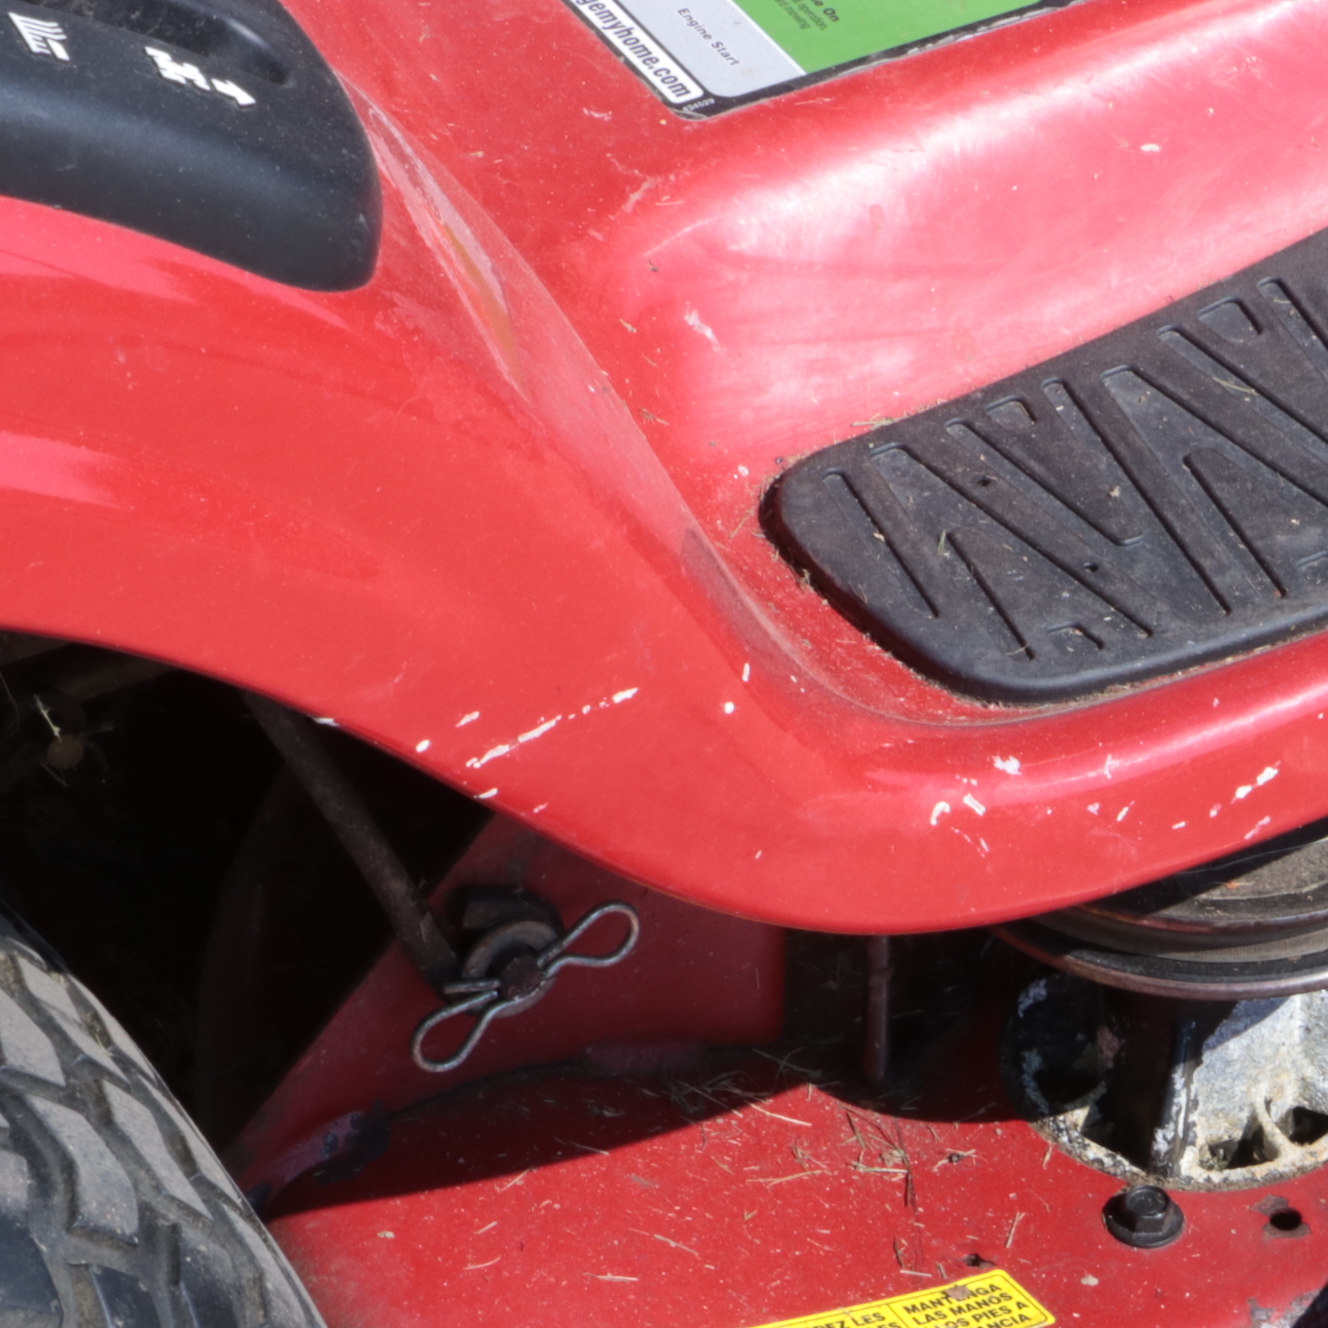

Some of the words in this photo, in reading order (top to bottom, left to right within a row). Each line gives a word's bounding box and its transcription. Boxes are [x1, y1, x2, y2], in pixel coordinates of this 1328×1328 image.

[677, 7, 712, 41] Engine
[711, 40, 740, 66] Start
[903, 1283, 1002, 1315] MANTNGA
[911, 1310, 948, 1326] LAS
[948, 1292, 1013, 1316] MANOS
[971, 1305, 1013, 1323] PIES
[1015, 1300, 1030, 1311] A
[851, 1311, 886, 1327] LES
